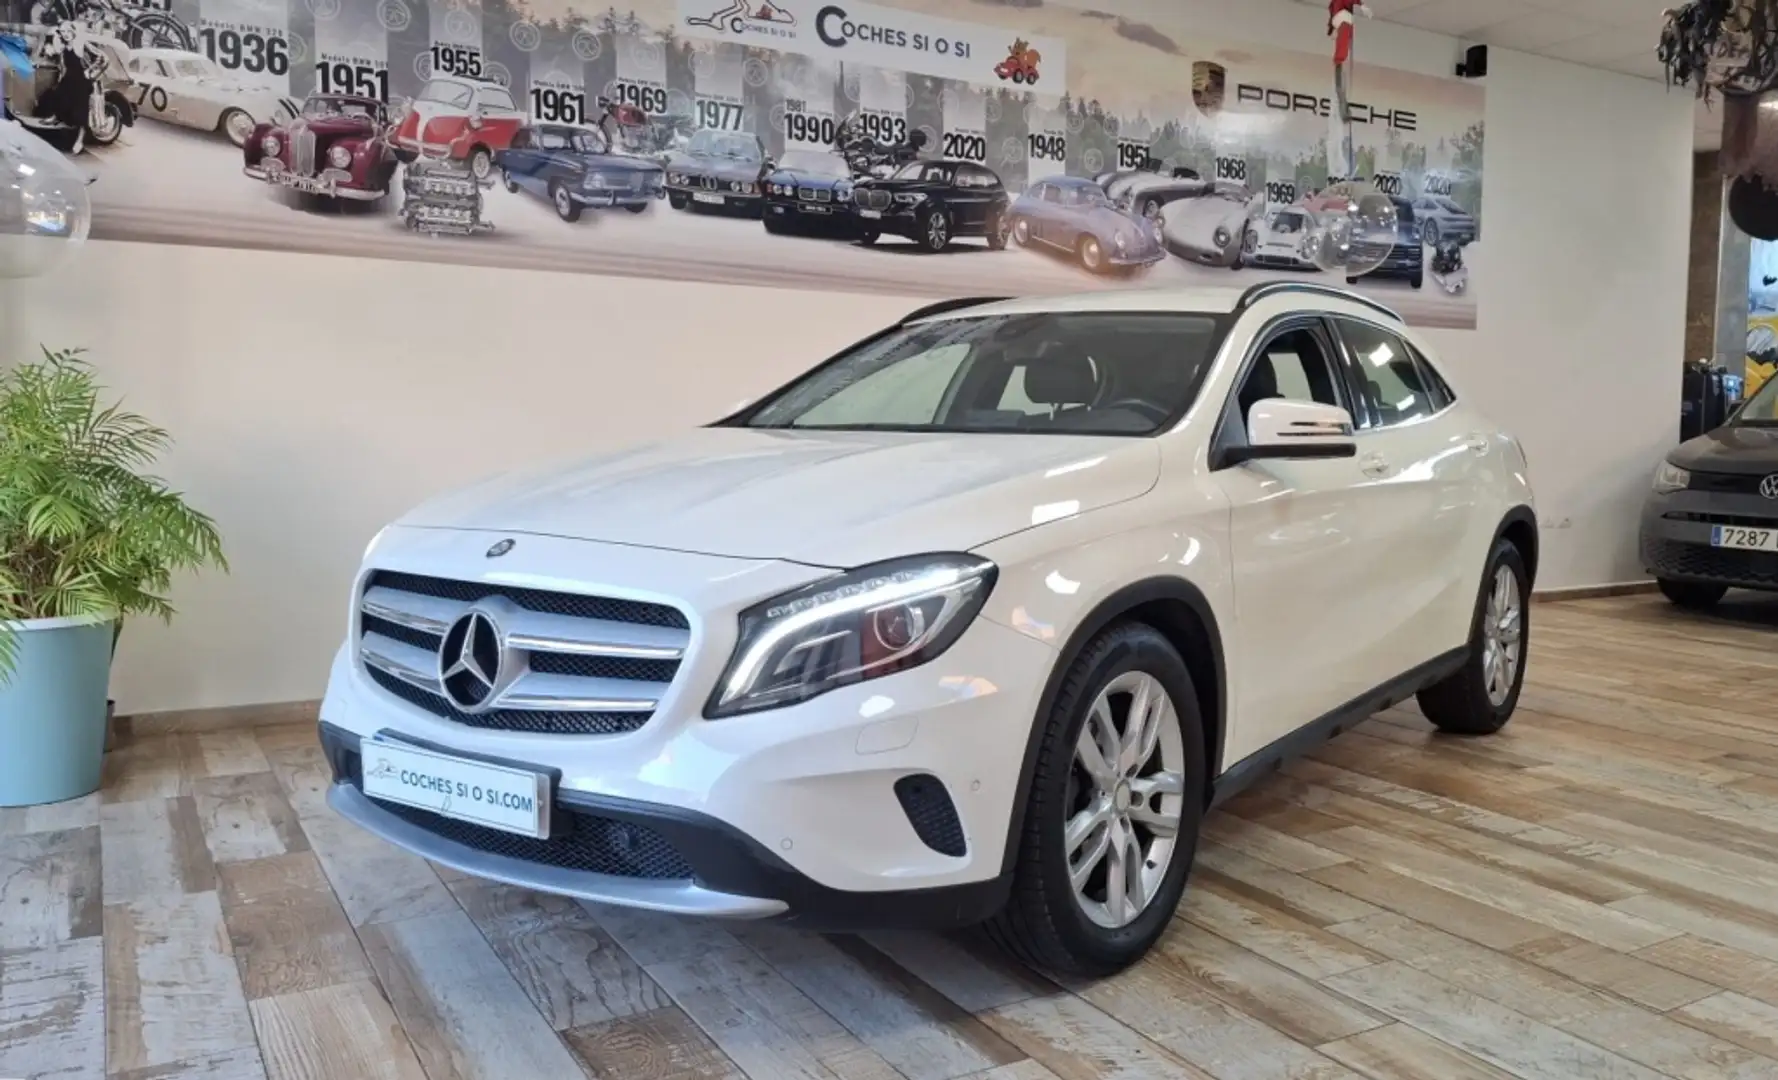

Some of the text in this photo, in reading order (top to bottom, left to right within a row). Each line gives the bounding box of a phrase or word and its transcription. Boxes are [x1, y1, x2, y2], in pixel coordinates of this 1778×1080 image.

[815, 5, 971, 59] COCHES SI O SI
[199, 27, 289, 76] 1936
[430, 46, 482, 76] 1955
[137, 81, 168, 112] 70
[315, 61, 389, 105] 1951
[615, 83, 667, 114] 1969
[529, 87, 585, 125] 1961
[696, 99, 745, 131] 1977
[783, 112, 834, 145] 1990
[859, 112, 906, 144] 1993
[943, 132, 986, 161] 2020
[1027, 133, 1066, 161] 1948
[1116, 142, 1151, 170] 1951
[1215, 156, 1246, 181] 1968
[1265, 182, 1296, 205] 1969
[1373, 173, 1401, 196] 2020
[1724, 528, 1770, 547] 7287
[400, 769, 533, 813] COCHES SI O SI.COM
